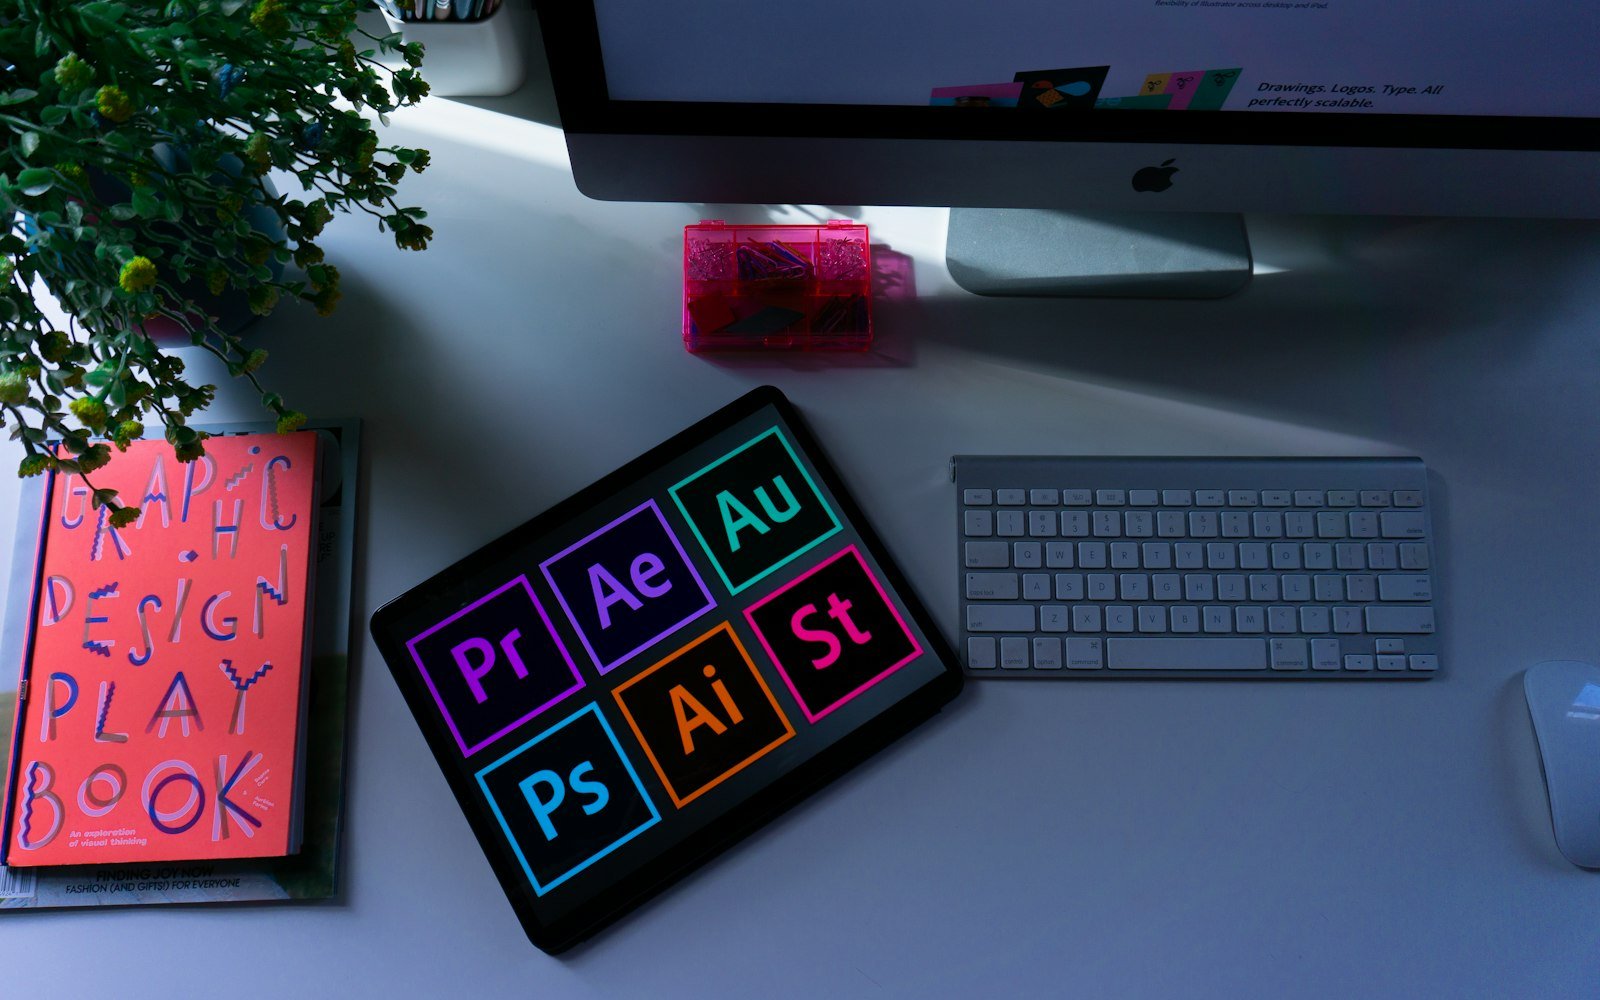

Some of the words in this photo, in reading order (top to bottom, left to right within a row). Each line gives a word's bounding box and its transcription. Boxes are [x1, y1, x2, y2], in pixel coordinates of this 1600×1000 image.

[1247, 96, 1312, 108] perfectly
[1315, 97, 1374, 108] scalable.
[1257, 82, 1327, 94] Drawings.
[1331, 84, 1376, 95] Logos.
[1382, 85, 1417, 96] Type.
[1421, 85, 1444, 95] All
[715, 474, 802, 553] Au
[43, 544, 288, 667] DESIGN
[587, 551, 673, 630] Ae
[450, 627, 529, 704] Pr
[790, 592, 873, 671] St
[40, 659, 273, 743] PLAY
[668, 664, 745, 756] Ai
[17, 750, 263, 850] BOOK
[69, 830, 81, 838] An
[84, 828, 136, 839] exploration
[518, 760, 610, 842] Ps
[68, 839, 78, 848] of
[81, 838, 107, 847] visual
[110, 837, 147, 847] thinking
[96, 869, 151, 882] FINDING
[152, 868, 178, 880] JOY
[180, 866, 215, 878] NOW
[65, 882, 108, 894] FASHION
[110, 881, 135, 893] (AND
[137, 880, 169, 892] GIFTS!)
[171, 880, 190, 890] FOR
[192, 878, 240, 889] EVERYONE
